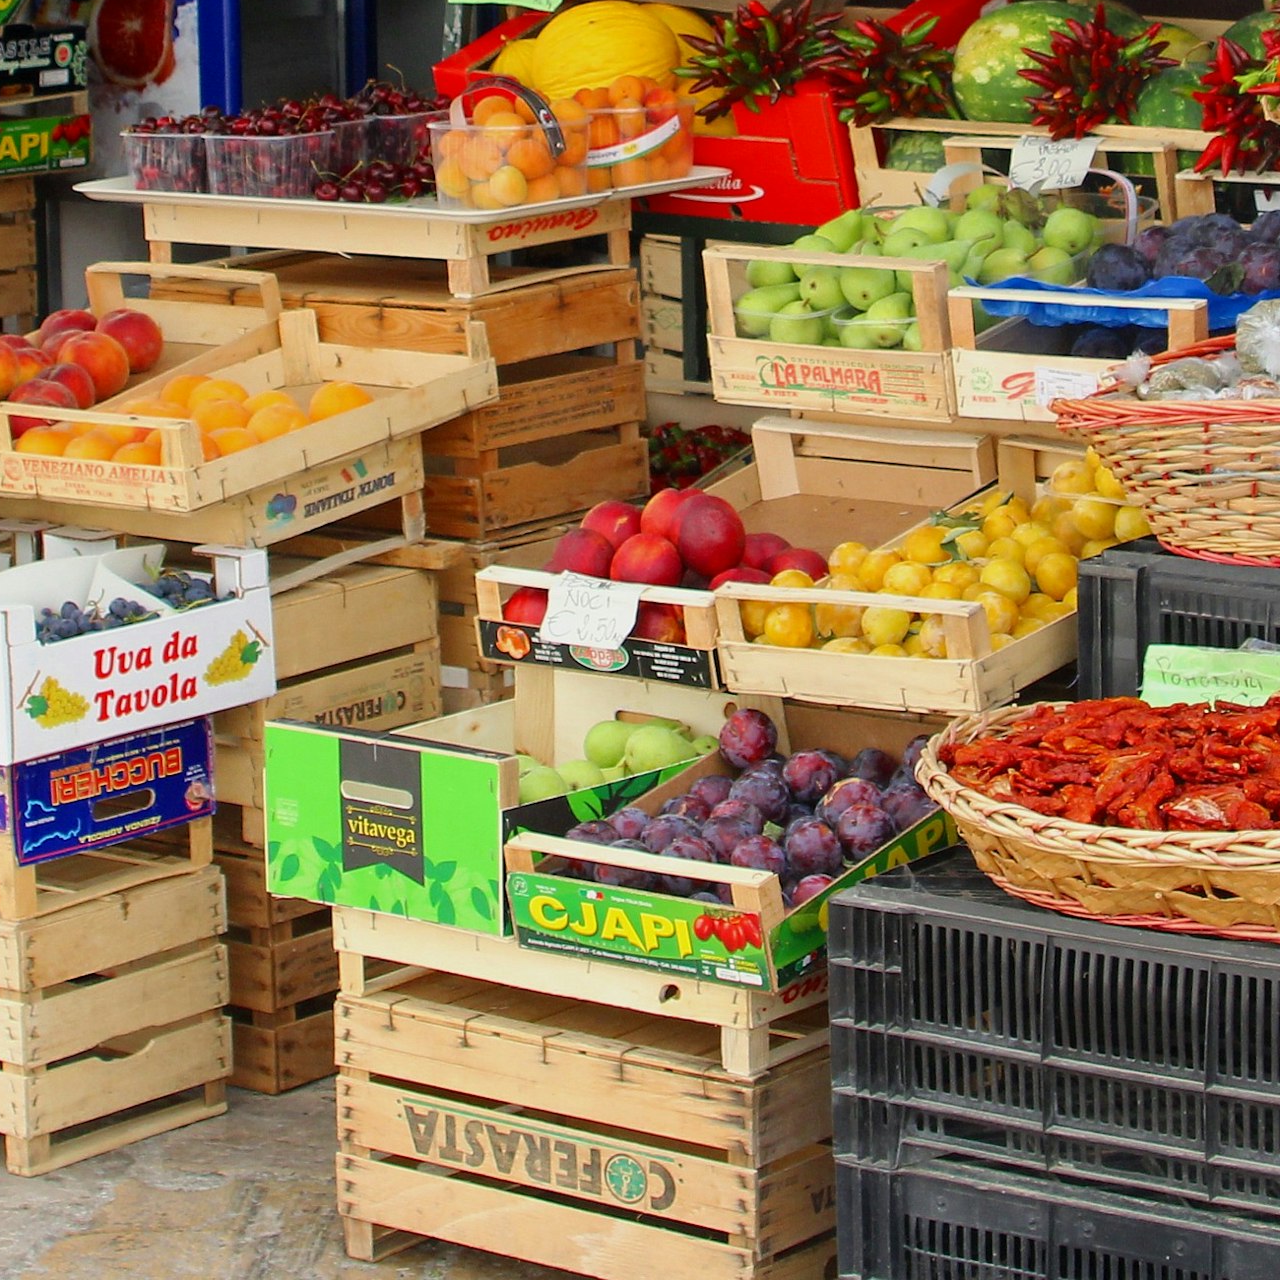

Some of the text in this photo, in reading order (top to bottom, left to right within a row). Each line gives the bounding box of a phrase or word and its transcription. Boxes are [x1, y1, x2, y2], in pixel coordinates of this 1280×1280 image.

[486, 207, 600, 244] Genuino
[773, 363, 797, 388] LA
[800, 364, 882, 395] PALMARA
[22, 458, 105, 478] VENEZIANO
[109, 464, 166, 484] AMELIA
[564, 587, 612, 610] NOCI
[547, 609, 577, 638] €
[93, 630, 199, 680] Uva da
[93, 672, 198, 723] Tavola
[50, 746, 183, 807] BUCCHERI
[78, 815, 162, 843] AZIENDA AGRICOLA
[347, 815, 416, 848] vitavega
[528, 895, 693, 959] CJAPI
[403, 1104, 677, 1212] COFERASTA
